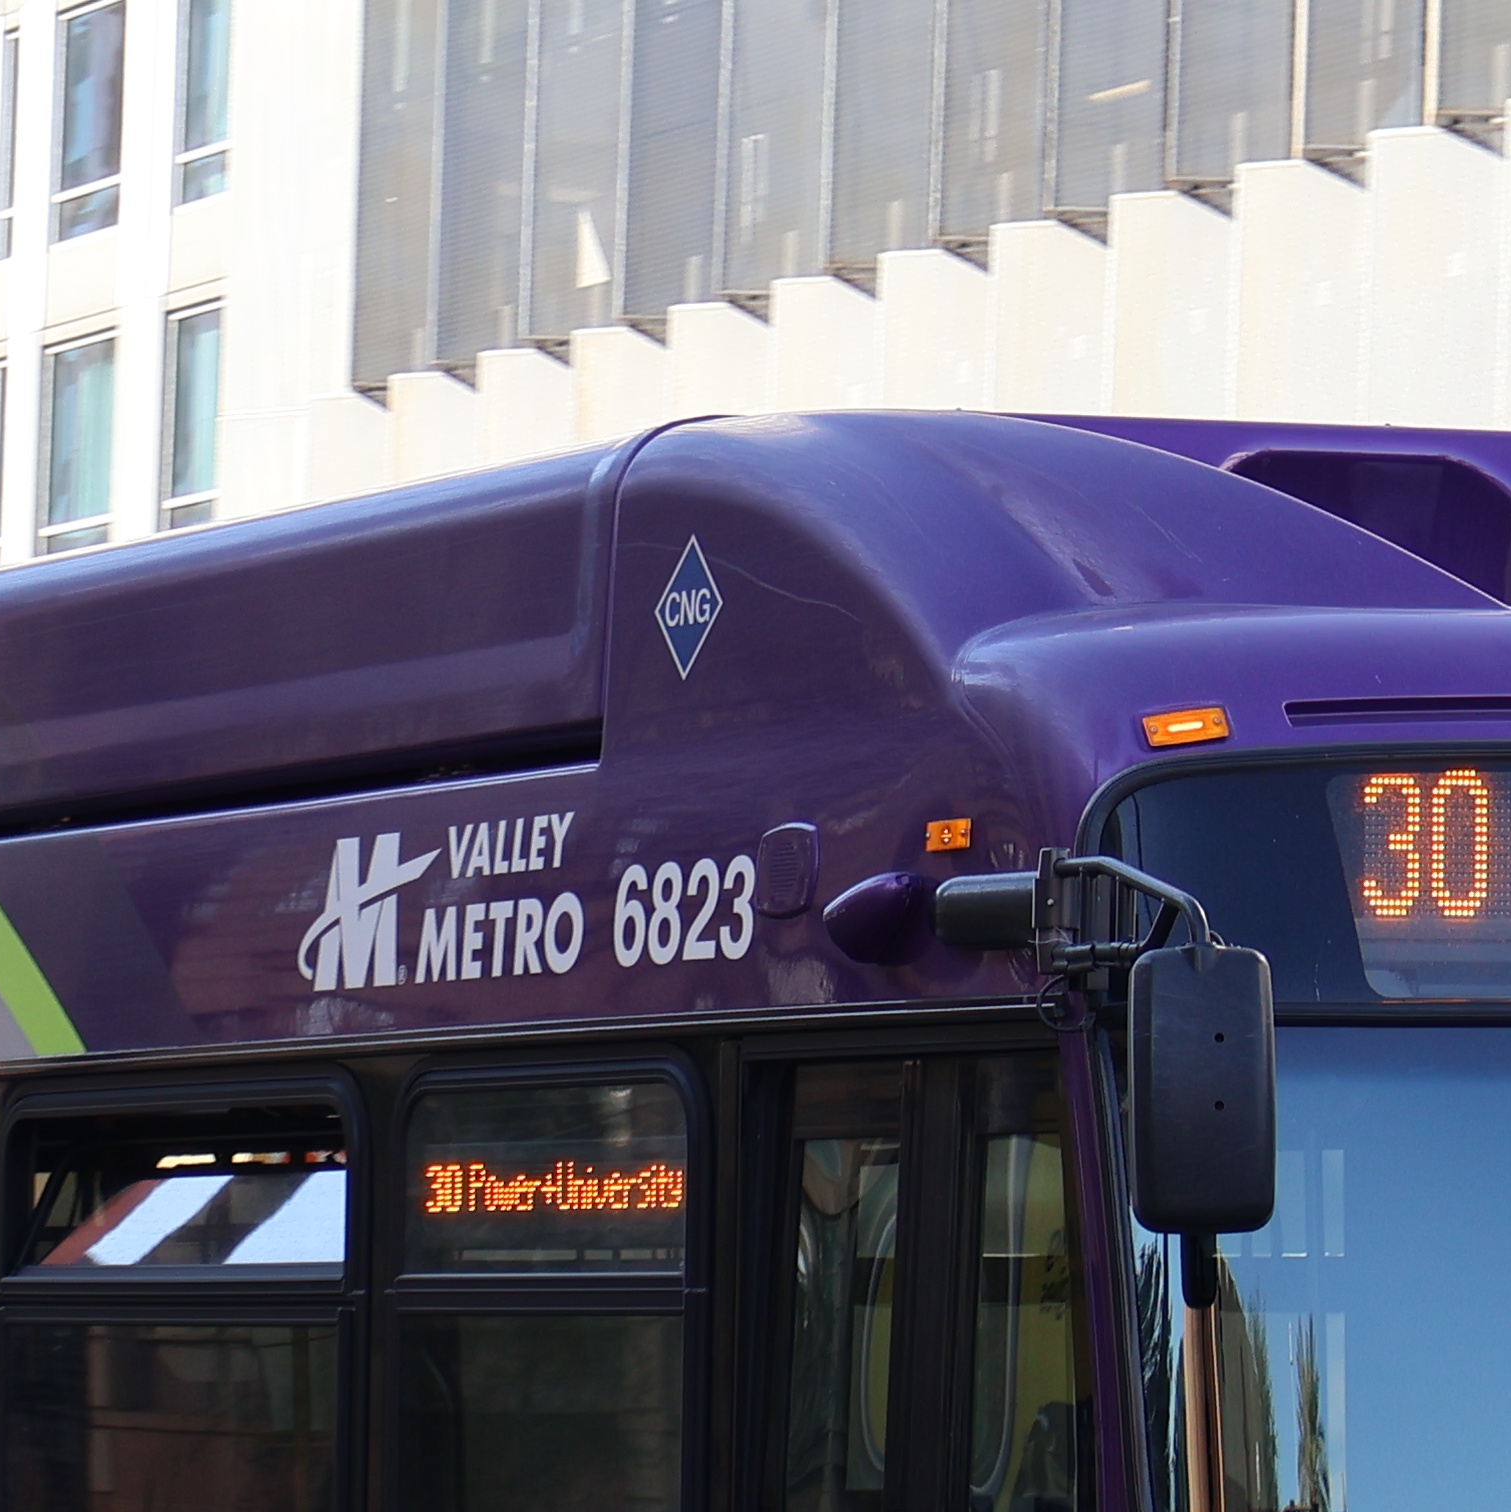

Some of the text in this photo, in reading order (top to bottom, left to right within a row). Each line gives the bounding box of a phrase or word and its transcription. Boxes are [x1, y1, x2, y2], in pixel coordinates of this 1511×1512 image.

[665, 588, 711, 628] CNG
[448, 811, 575, 879] VALLEY
[1362, 768, 1492, 921] 30
[415, 854, 756, 984] METRO 6823
